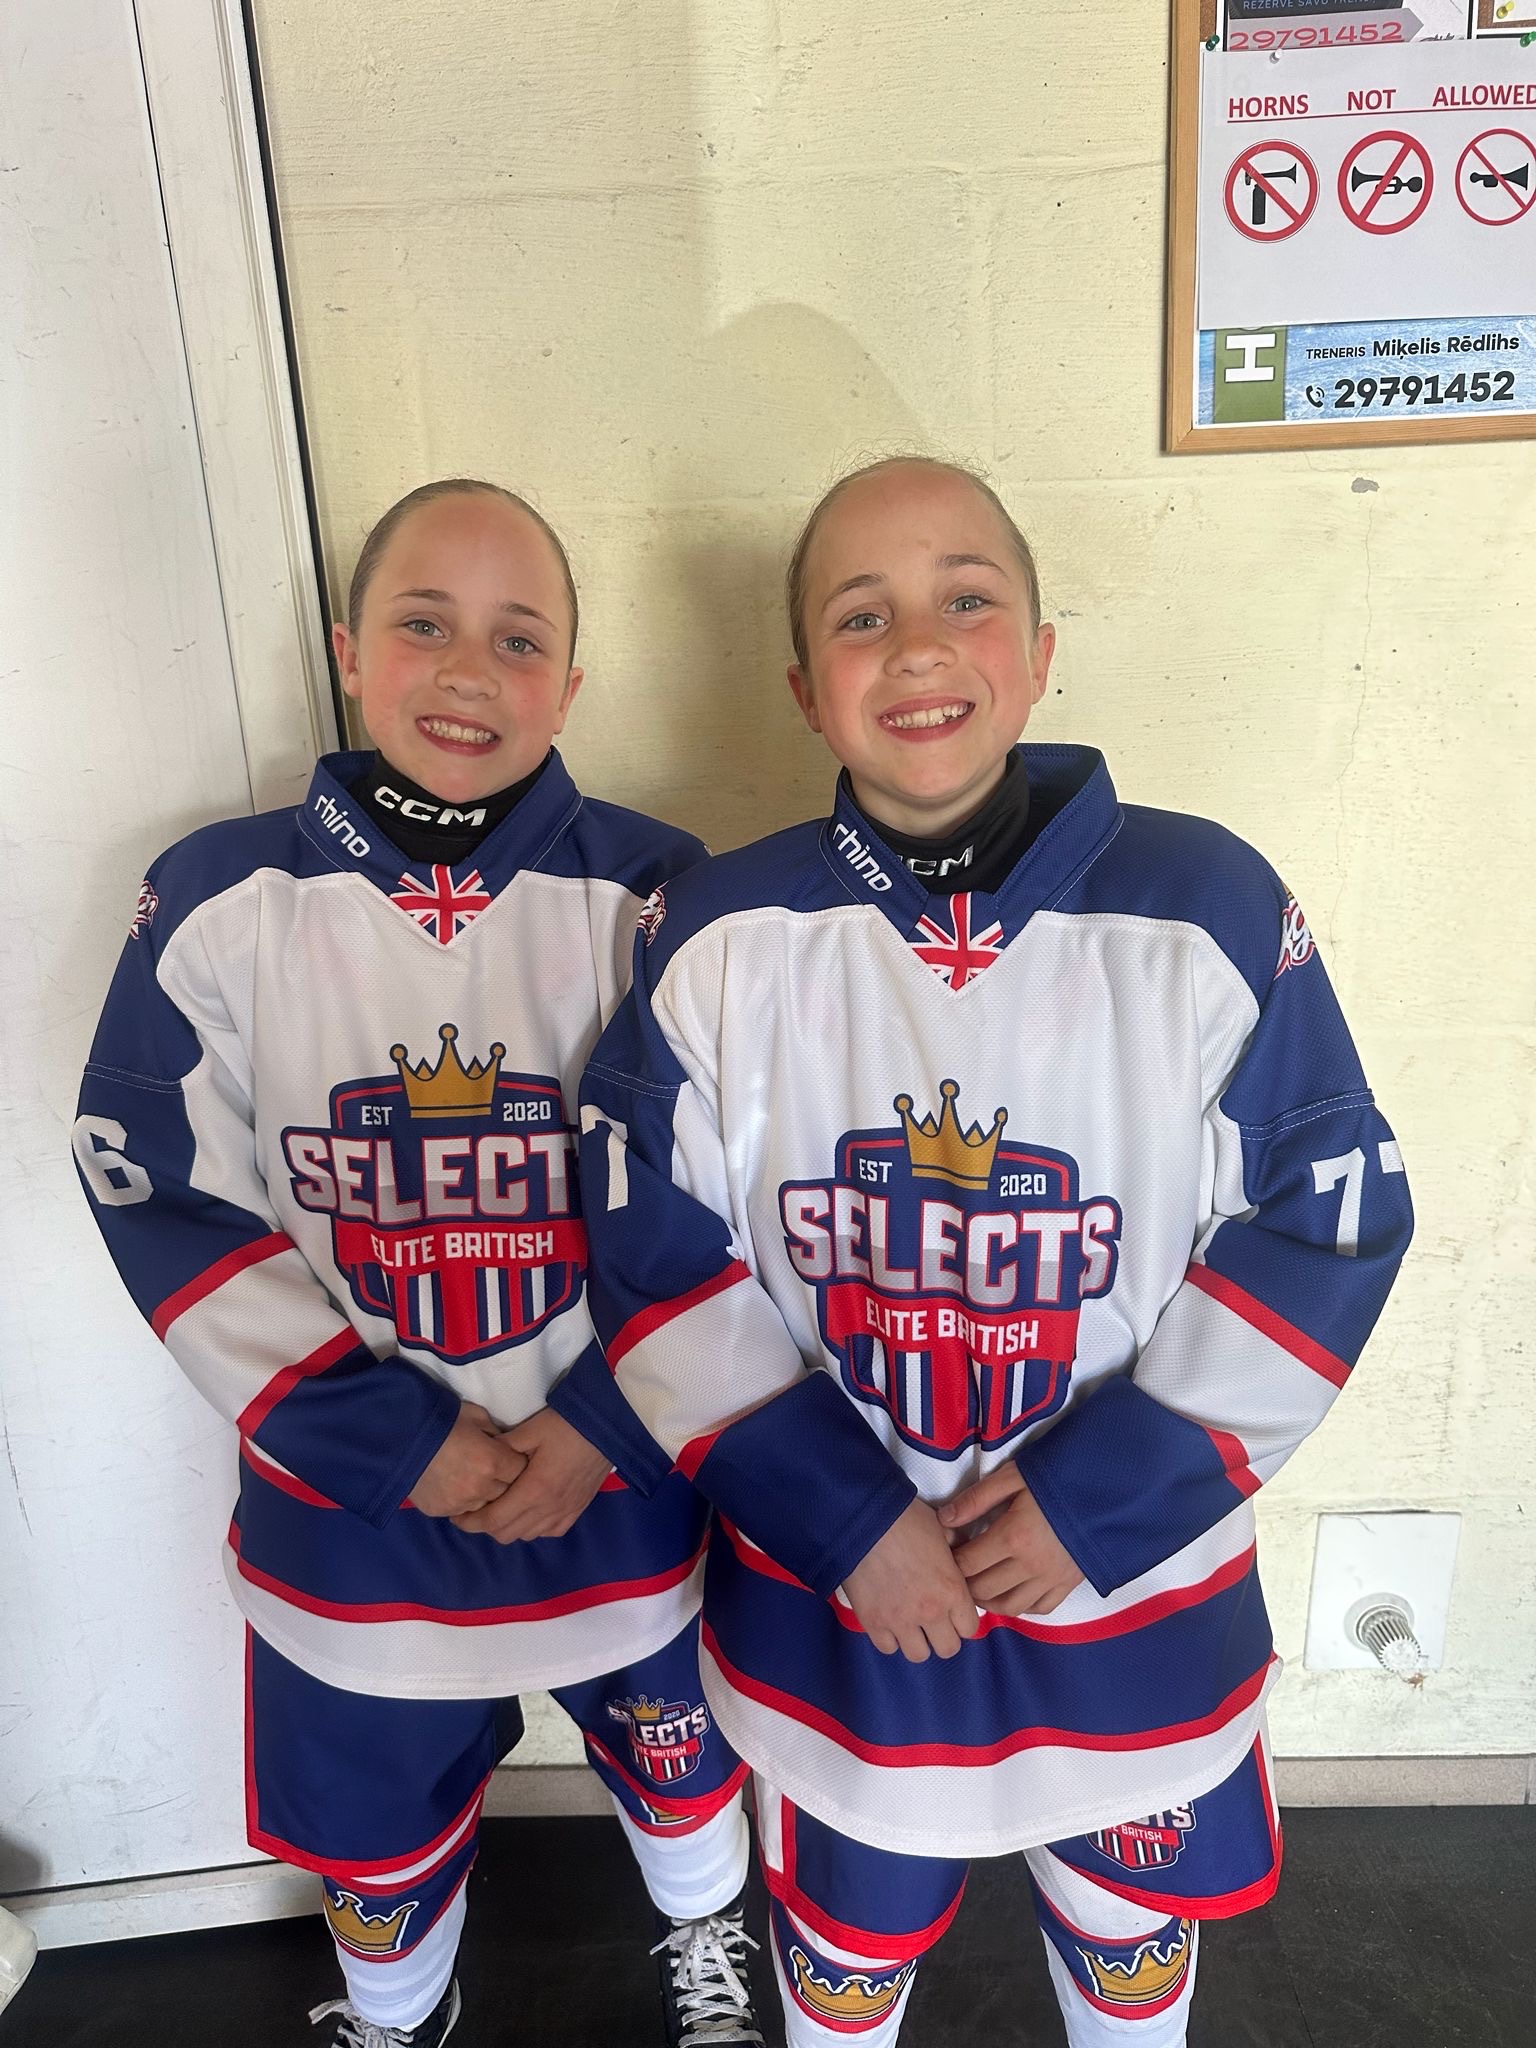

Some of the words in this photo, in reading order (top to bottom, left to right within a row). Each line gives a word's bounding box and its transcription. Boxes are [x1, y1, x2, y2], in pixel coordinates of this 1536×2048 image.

[1229, 22, 1404, 50] 29791452
[1228, 94, 1309, 119] HORNS
[1347, 89, 1397, 112] NOT
[1432, 84, 1536, 107] ALLOWED
[1306, 346, 1366, 360] TRENERIS
[1373, 336, 1441, 360] Miķelis
[1447, 333, 1520, 353] Rēdlihs
[1334, 370, 1516, 409] 29791452
[374, 785, 488, 827] CCM
[314, 793, 372, 859] rhino
[832, 822, 893, 892] rhino
[896, 844, 975, 877] CM
[361, 1105, 393, 1126] EST
[503, 1100, 551, 1122] 2020
[286, 1132, 578, 1223] SELECT
[858, 1158, 893, 1184] EST
[1000, 1173, 1046, 1197] 2020
[370, 1234, 435, 1268] ELITE
[444, 1229, 553, 1260] BRITISH
[783, 1185, 1117, 1307] SELECTS
[865, 1295, 928, 1342] ELITE
[938, 1307, 1040, 1356] BRITISH
[651, 1745, 687, 1758] BRITISH
[1121, 1824, 1163, 1842] BRITISH
